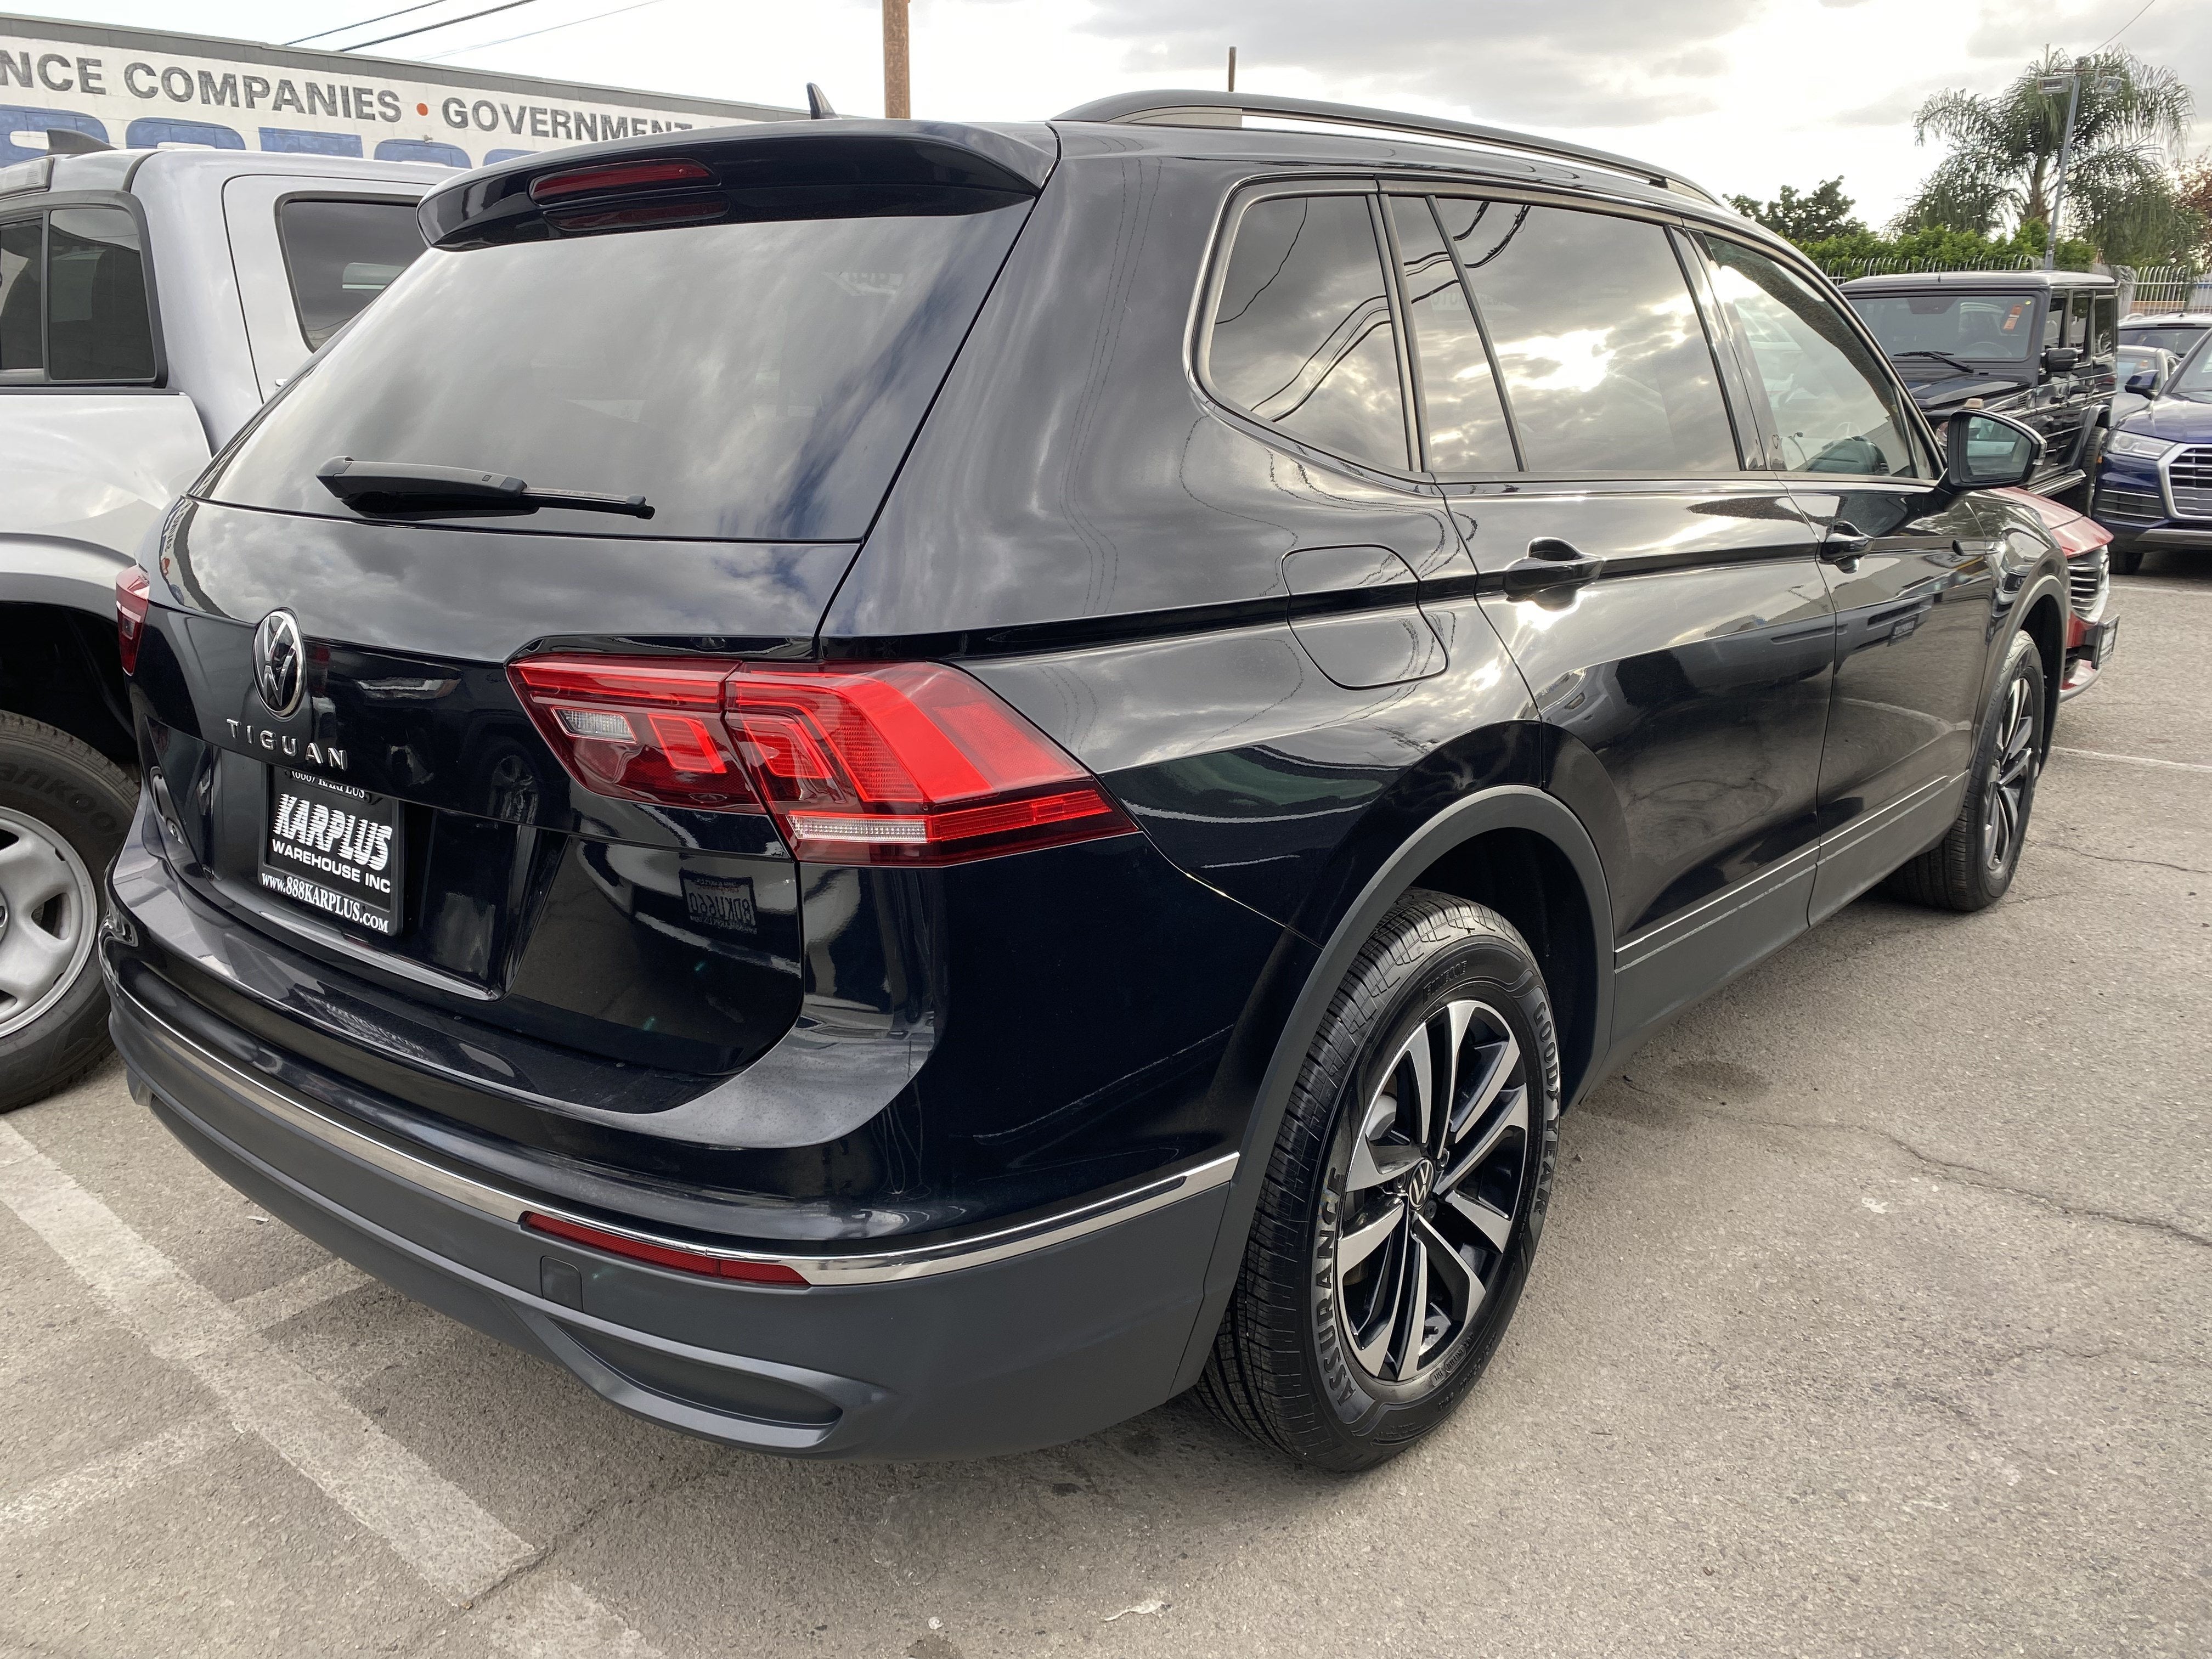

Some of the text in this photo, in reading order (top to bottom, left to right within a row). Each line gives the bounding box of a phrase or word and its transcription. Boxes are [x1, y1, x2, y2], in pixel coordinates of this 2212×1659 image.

[0, 51, 106, 95] NCE
[124, 62, 402, 122] COMPANIES
[227, 717, 348, 771] TIGUAN
[272, 839, 391, 894] WAREHOUSE INC
[273, 794, 393, 871] KARPLUS
[1316, 1167, 1356, 1407] ASSURANCE
